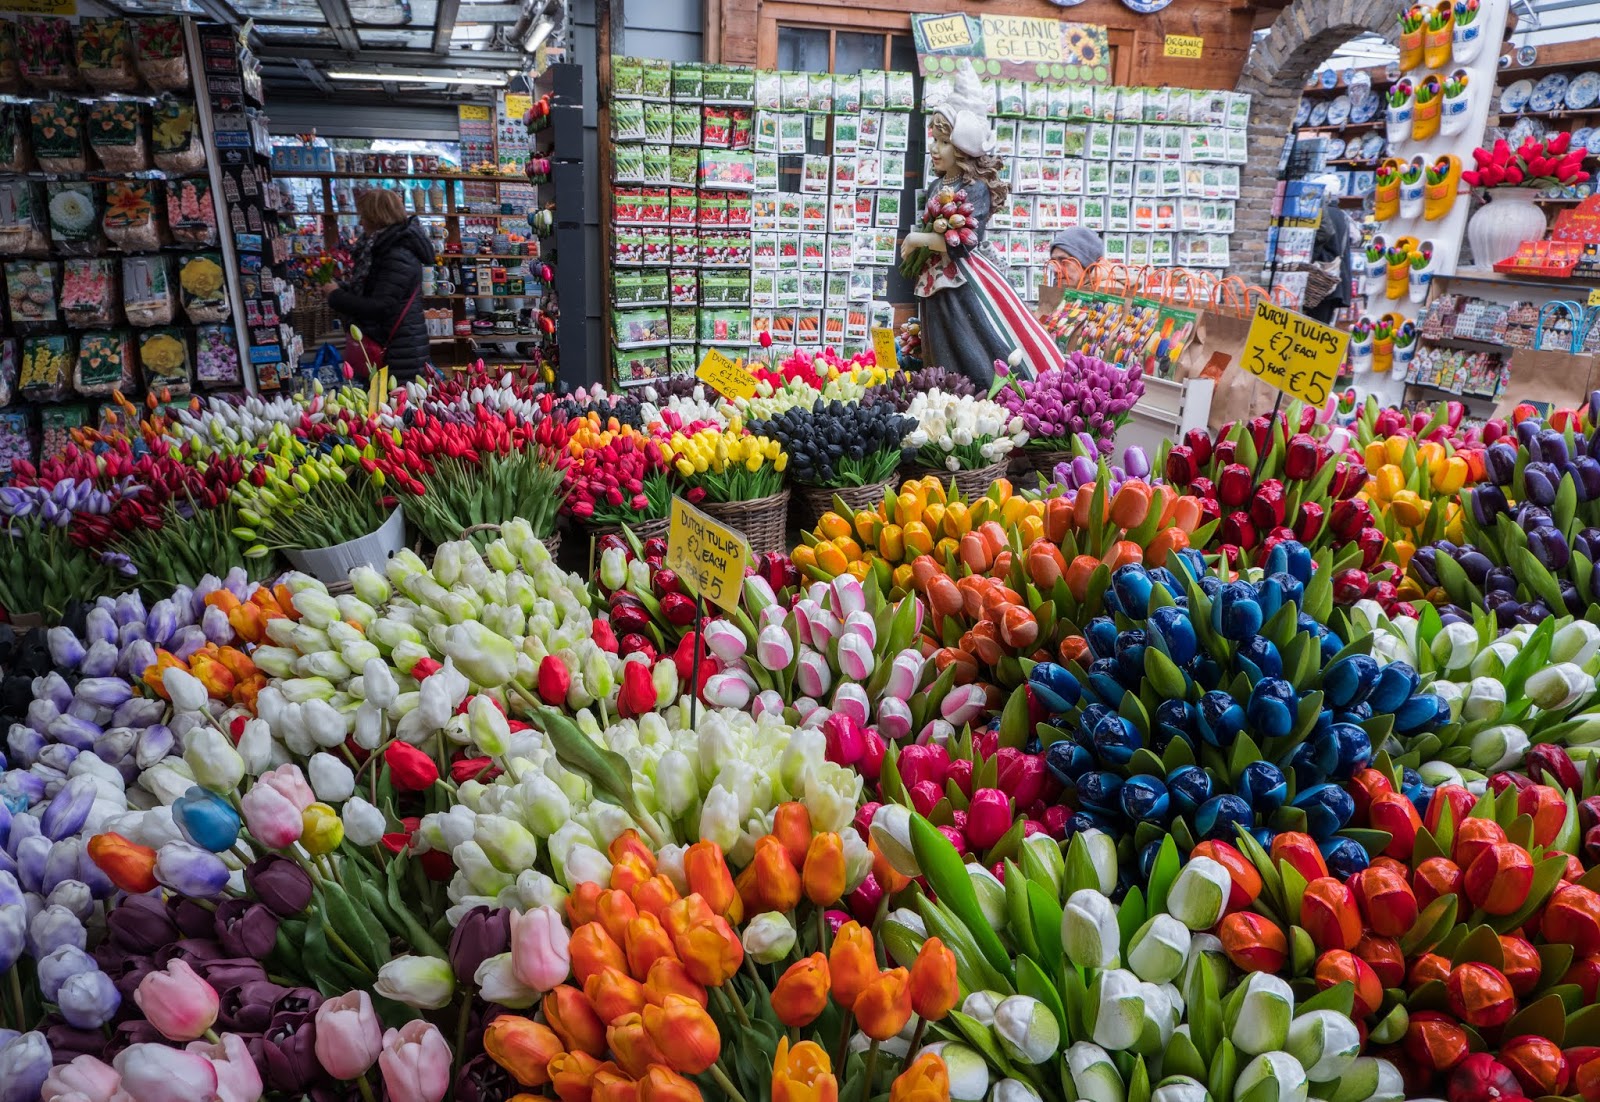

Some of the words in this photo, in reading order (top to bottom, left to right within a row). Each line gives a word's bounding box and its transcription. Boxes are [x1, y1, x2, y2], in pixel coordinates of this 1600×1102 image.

[927, 20, 955, 35] LOW
[929, 31, 971, 47] PRICES
[982, 18, 1060, 40] ORGANIC
[996, 38, 1060, 60] SEEDS
[1166, 37, 1203, 48] ORGANIC
[1167, 46, 1199, 57] SEEDS
[1258, 303, 1289, 330] DUTCH
[1294, 320, 1338, 354] TULIPS
[1249, 345, 1266, 375] 3
[1267, 362, 1287, 377] FOR
[1294, 344, 1318, 361] EACH
[711, 352, 733, 370] DUTCH
[735, 368, 757, 386] TULIPS
[707, 372, 717, 382] 5
[723, 386, 739, 399] €6
[681, 509, 705, 541] DUTCH
[706, 529, 740, 559] TULIPS
[687, 534, 701, 561] €2
[702, 549, 727, 574] EACH
[675, 546, 683, 569] 3
[699, 569, 724, 600] €5
